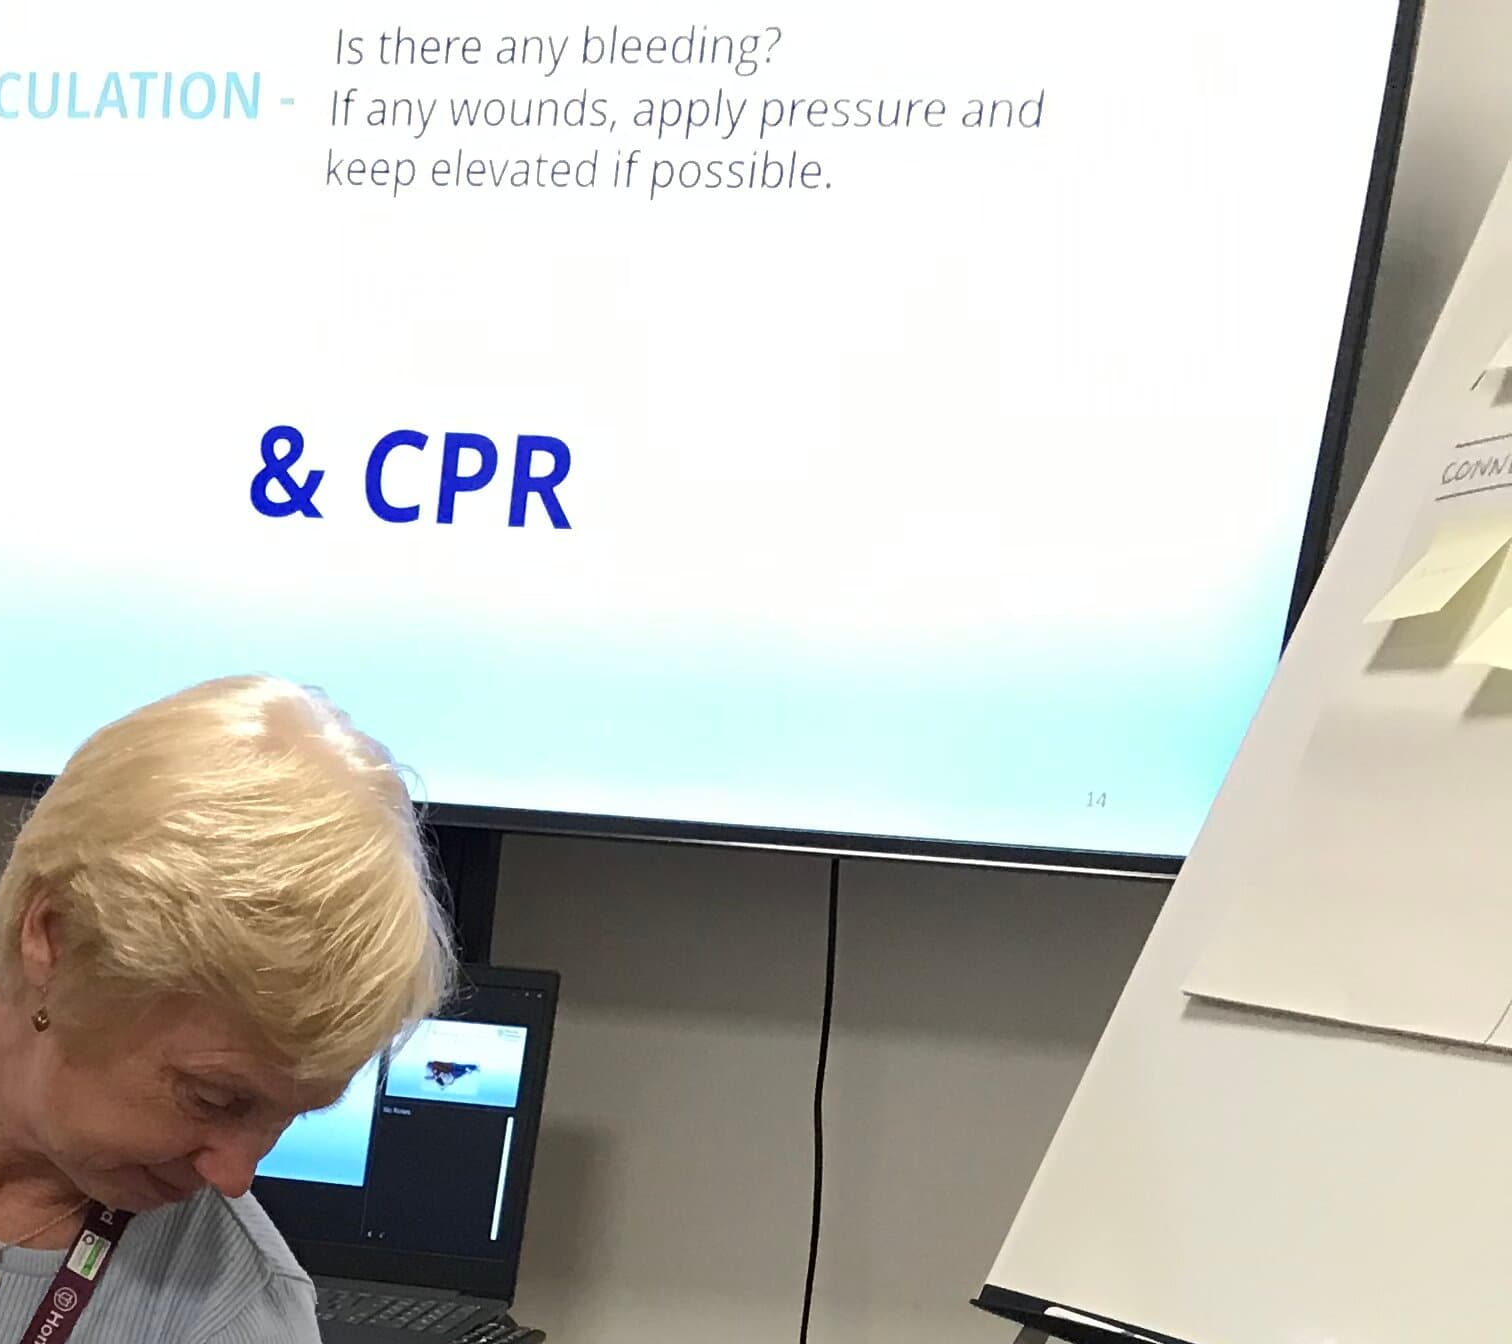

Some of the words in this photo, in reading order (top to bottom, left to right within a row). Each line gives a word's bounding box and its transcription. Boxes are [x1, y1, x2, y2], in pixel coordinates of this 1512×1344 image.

[337, 28, 364, 65] Is
[380, 26, 481, 65] there
[496, 36, 569, 77] any
[582, 25, 782, 77] bleeding?
[332, 88, 358, 126] If
[367, 98, 437, 139] any
[450, 88, 617, 133] wounds,
[633, 88, 747, 140] apply
[760, 98, 946, 139] pressure
[961, 88, 1045, 128] and
[326, 148, 416, 198] keep
[431, 149, 598, 188] elevated
[613, 150, 641, 188] if
[650, 150, 832, 200] possible.
[250, 425, 325, 518] &
[365, 429, 572, 529] CPR
[1441, 453, 1512, 485] CONN
[1086, 791, 1106, 808] 14
